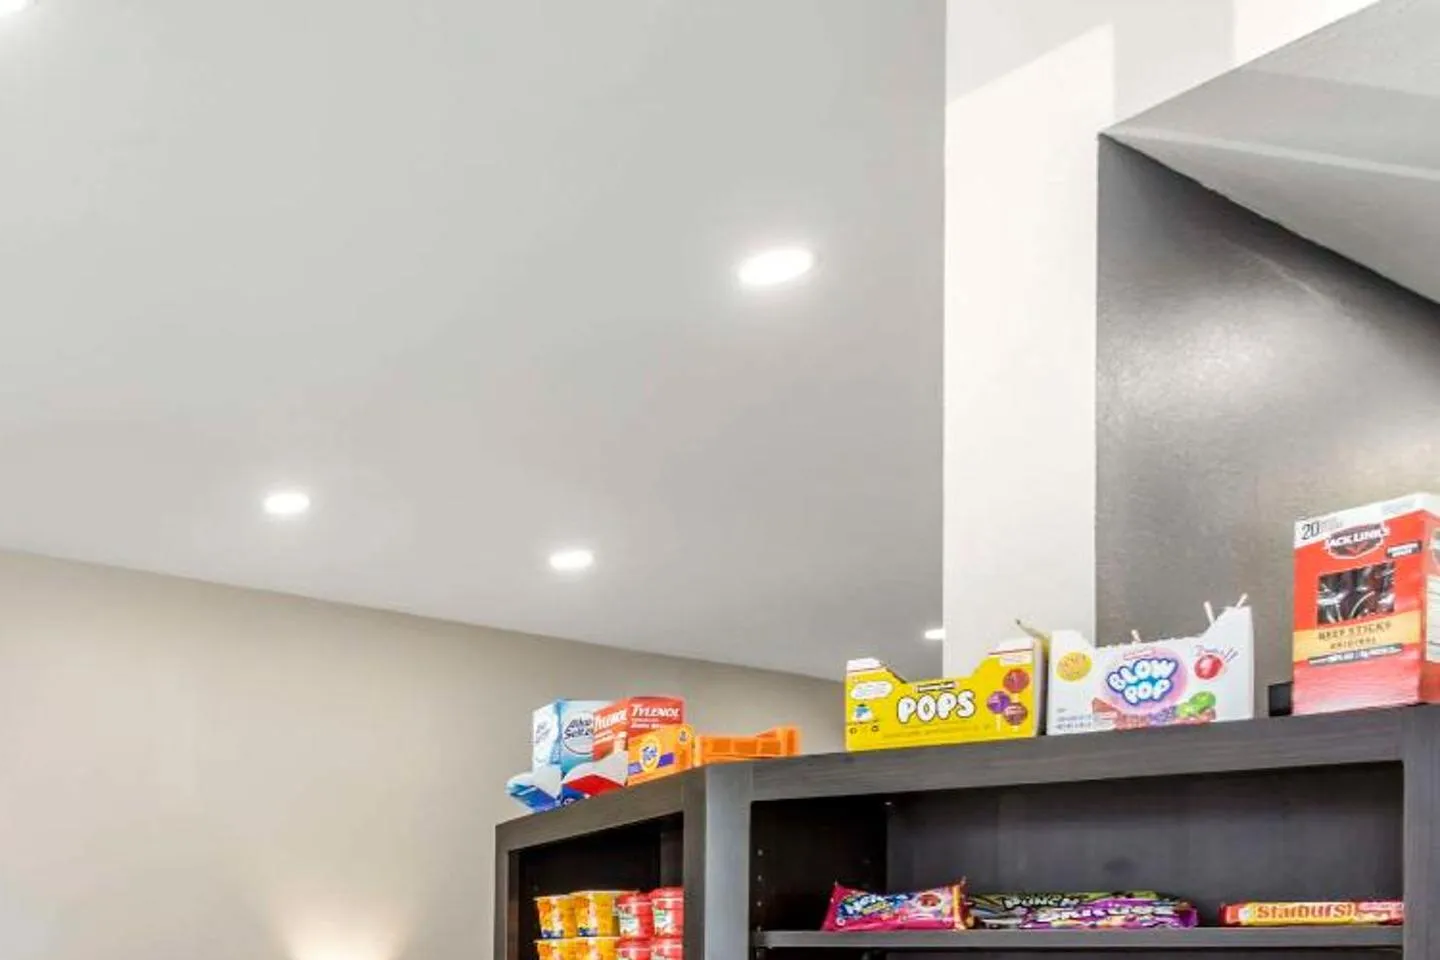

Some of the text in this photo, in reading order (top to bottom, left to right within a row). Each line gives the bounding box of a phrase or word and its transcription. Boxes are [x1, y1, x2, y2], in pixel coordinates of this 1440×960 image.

[1107, 658, 1179, 692] BLOW
[896, 690, 977, 725] POPS
[1123, 680, 1173, 706] POP
[631, 703, 681, 718] TYLENOL
